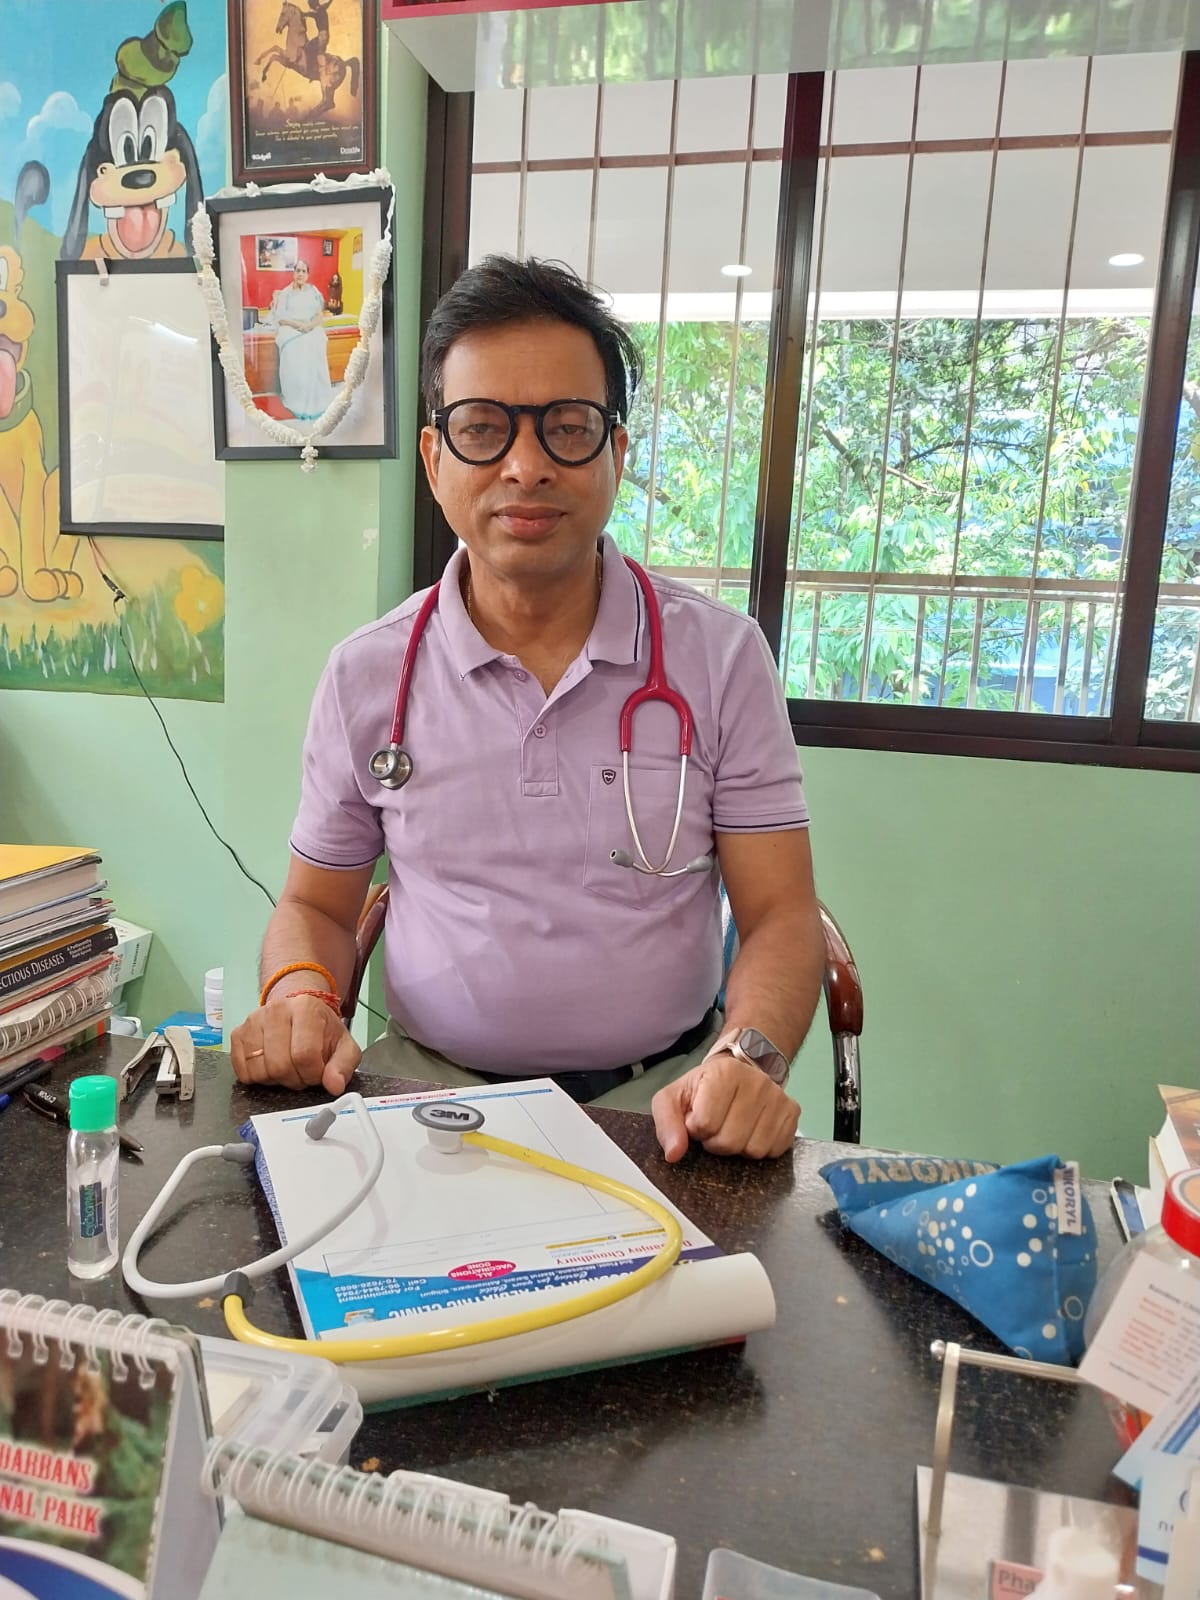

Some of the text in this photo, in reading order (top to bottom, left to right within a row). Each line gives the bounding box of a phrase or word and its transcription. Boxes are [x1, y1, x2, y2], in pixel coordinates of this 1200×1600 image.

[30, 952, 65, 975] DISEASES
[430, 1109, 470, 1121] 3M
[467, 1261, 492, 1269] DONE
[556, 1251, 625, 1265] Choudhury
[450, 1263, 514, 1278] VACCINATIONS
[408, 1278, 428, 1287] Cell
[479, 1284, 508, 1294] Child
[338, 1288, 401, 1304] Appointment
[43, 1495, 101, 1533] PARK
